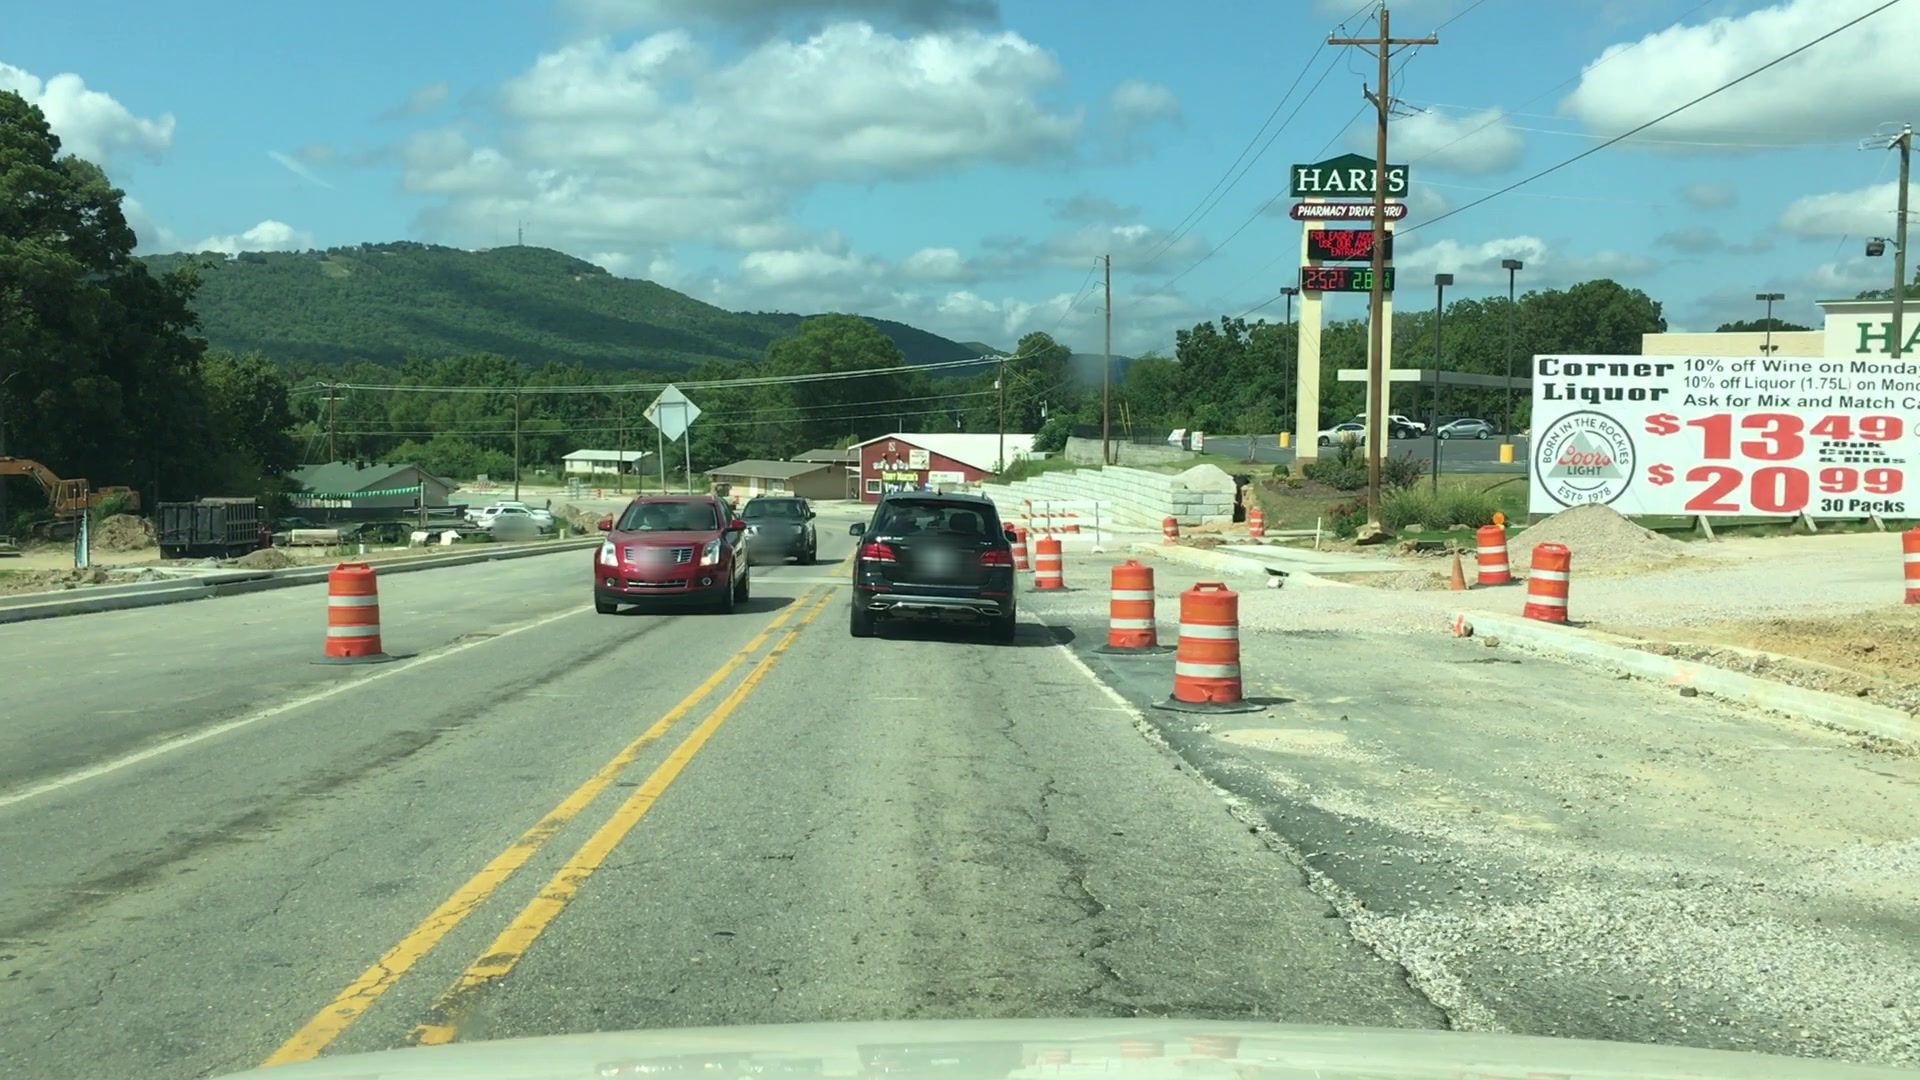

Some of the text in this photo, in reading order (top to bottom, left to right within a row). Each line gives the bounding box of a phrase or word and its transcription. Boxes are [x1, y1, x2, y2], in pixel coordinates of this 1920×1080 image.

[1297, 206, 1403, 217] PHARMACY DRIVE HRU
[1353, 272, 1373, 289] 2.8
[1539, 359, 1674, 376] Corner
[1684, 359, 1920, 376] 10% off Wine on Monda
[1684, 376, 1715, 389] 10%
[1720, 376, 1742, 389] off
[1745, 377, 1796, 391] Liquor
[1857, 380, 1876, 390] on
[1542, 383, 1669, 404] Liquor
[1683, 394, 1719, 407] Ask
[1726, 394, 1751, 407] for
[1758, 394, 1791, 407] Mix
[1797, 395, 1833, 408] and
[1840, 396, 1895, 409] Match
[1542, 417, 1629, 464] BORN IN THE ROCKIES
[1558, 445, 1612, 466] Coors
[1567, 466, 1602, 476] LIGHT
[1588, 487, 1612, 502] 1978
[1821, 498, 1905, 513] 30 Packs
